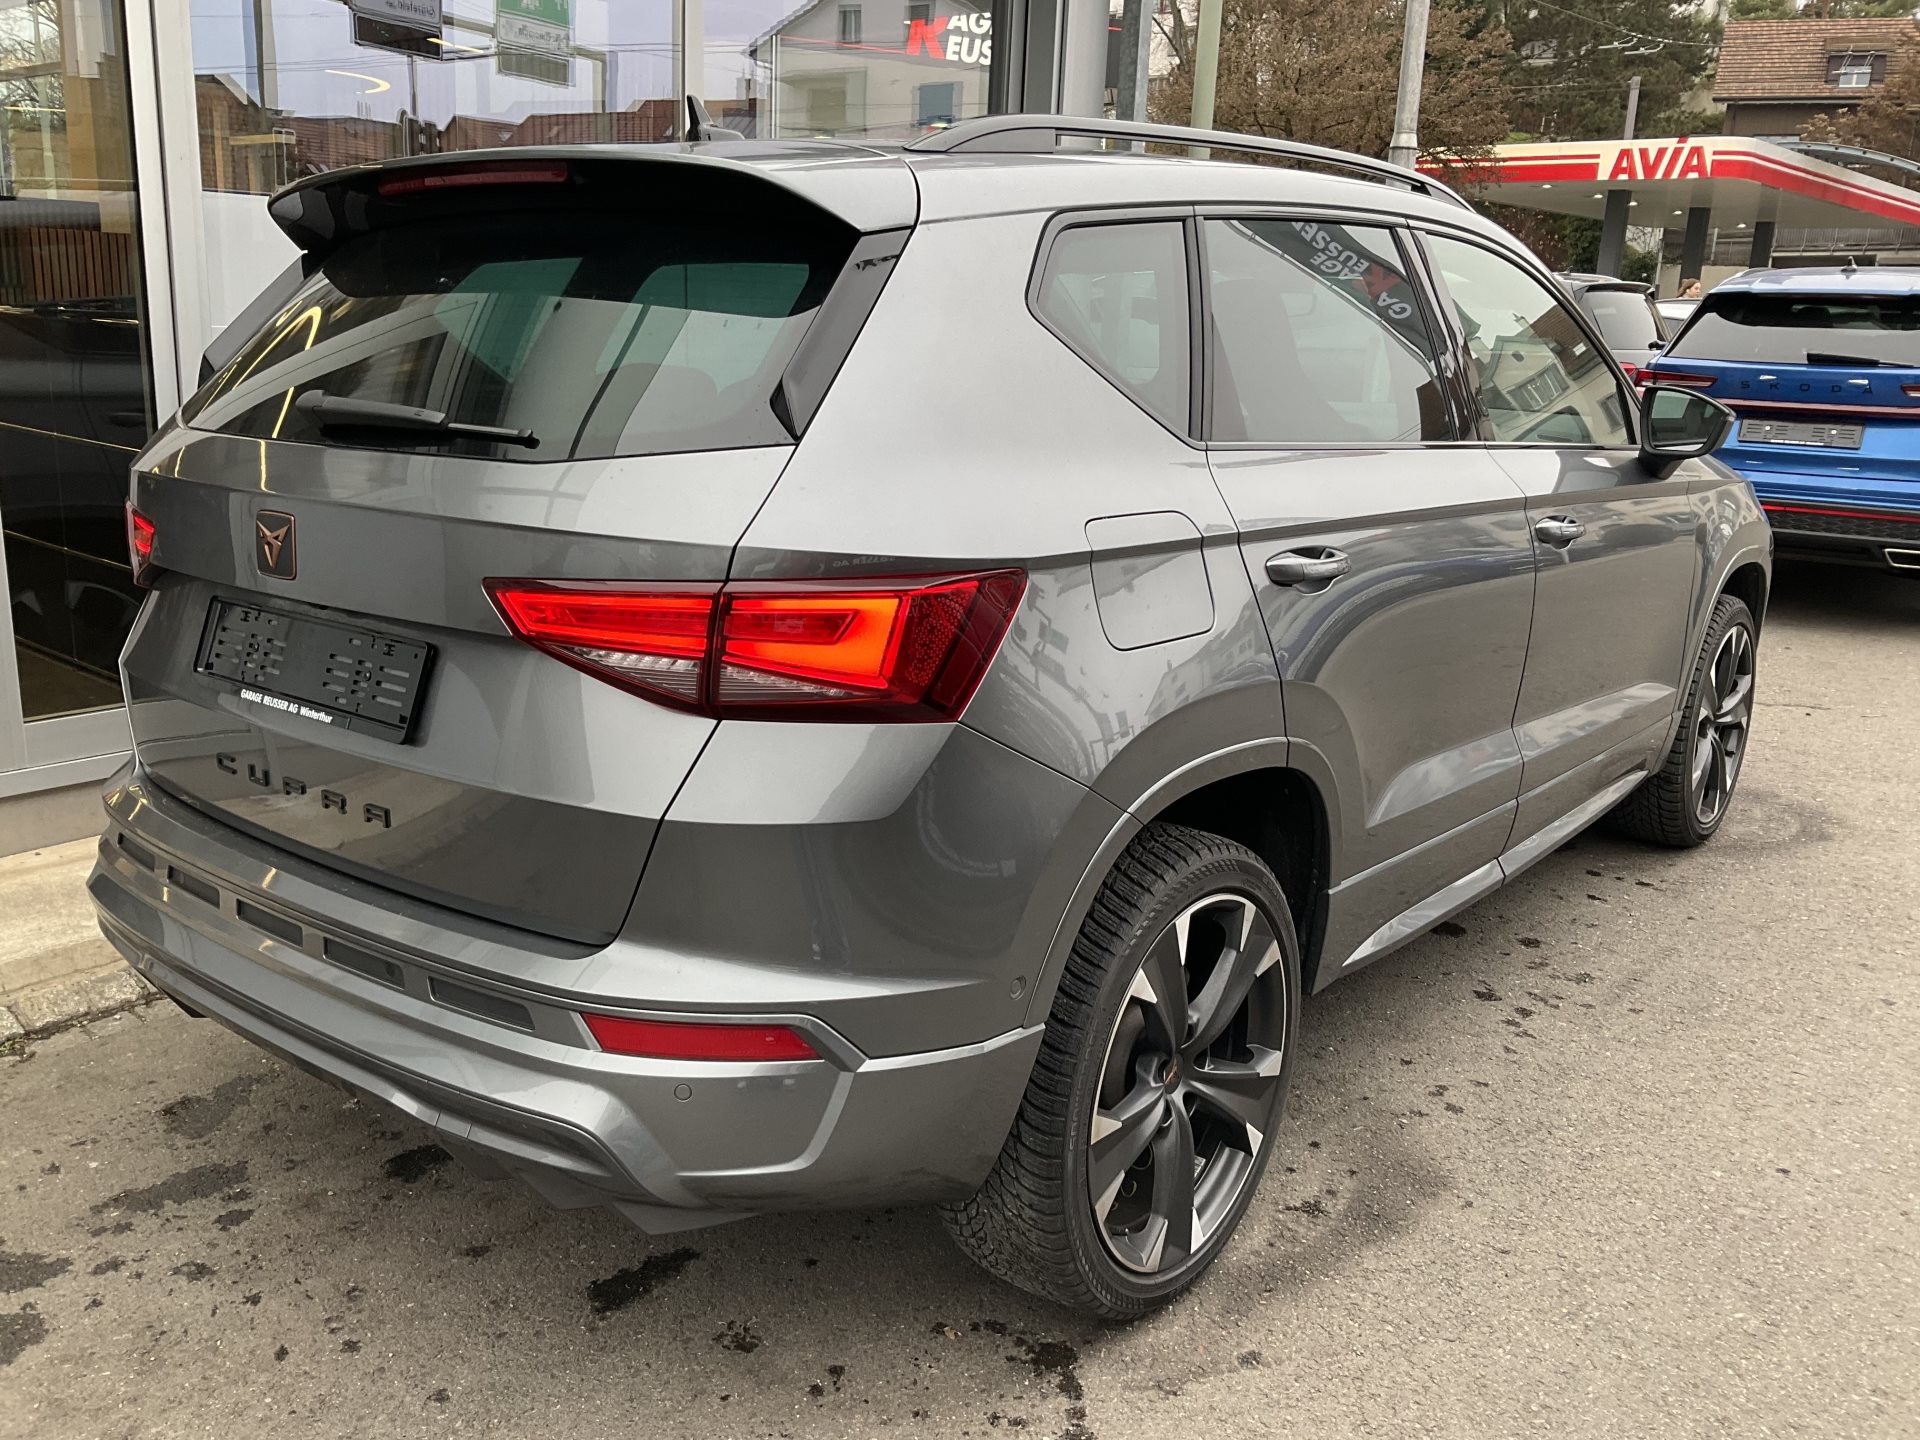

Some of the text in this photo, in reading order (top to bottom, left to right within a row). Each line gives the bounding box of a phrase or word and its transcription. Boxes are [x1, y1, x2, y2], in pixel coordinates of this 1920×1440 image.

[240, 688, 334, 724] GARAGE REUSSER AG Winterthur
[216, 752, 392, 829] CUPRA
